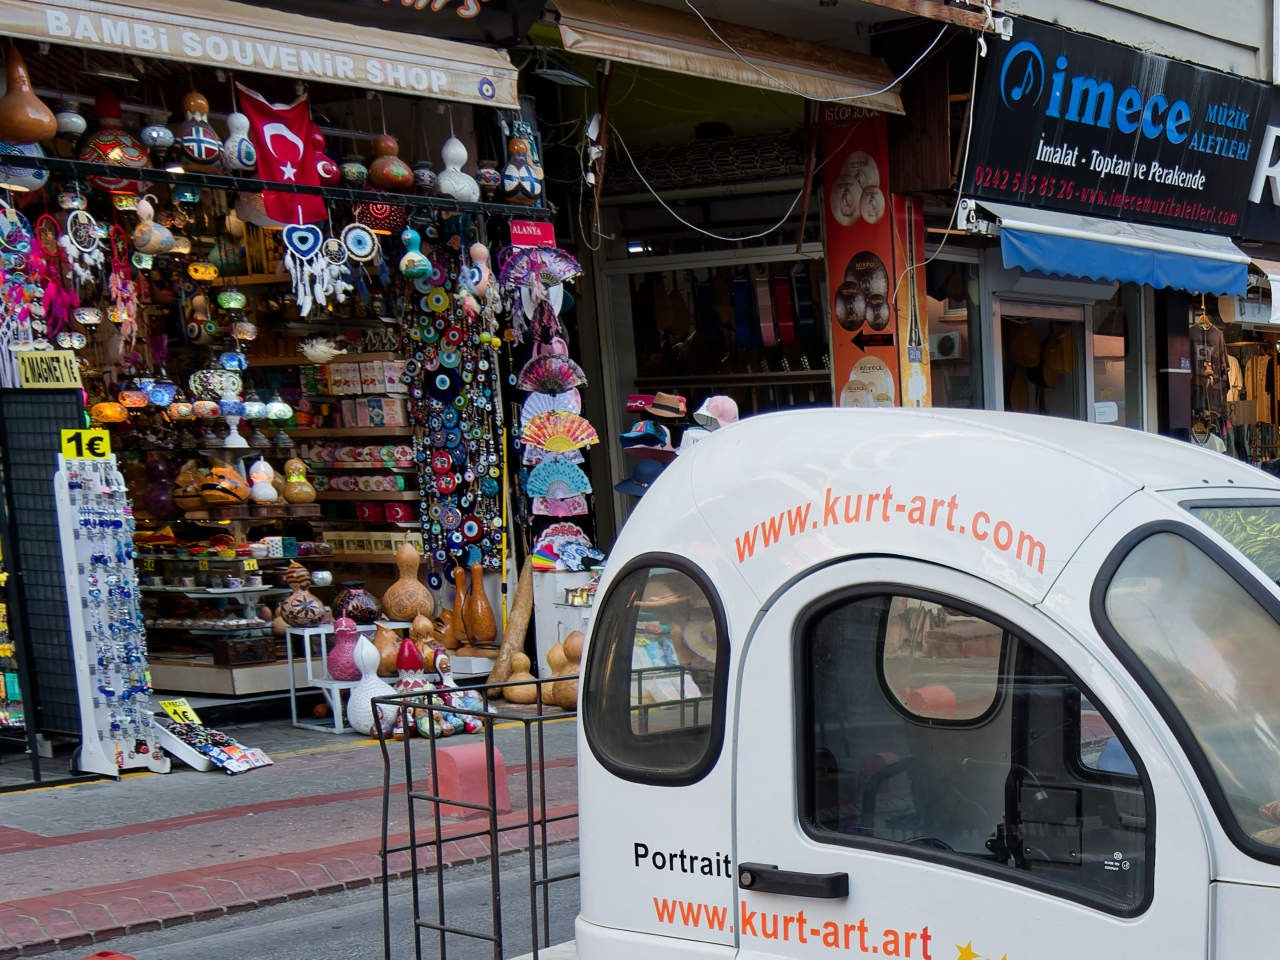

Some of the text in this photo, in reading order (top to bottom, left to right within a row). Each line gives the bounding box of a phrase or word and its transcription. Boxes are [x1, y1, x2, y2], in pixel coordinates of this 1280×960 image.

[364, 60, 448, 93] SHOP
[1045, 55, 1191, 145] imece
[975, 164, 1010, 191] 0242
[1089, 150, 1131, 179] Toptan
[1132, 162, 1147, 181] ve
[1147, 161, 1206, 191] Perakende
[512, 225, 542, 236] ALANYA
[21, 356, 30, 383] 2
[27, 356, 64, 383] MAGNET
[66, 431, 106, 458] 1€
[735, 484, 1046, 574] www.kurt-art.com
[633, 842, 732, 879] Portrait
[652, 896, 932, 960] www.kurt-art.art
